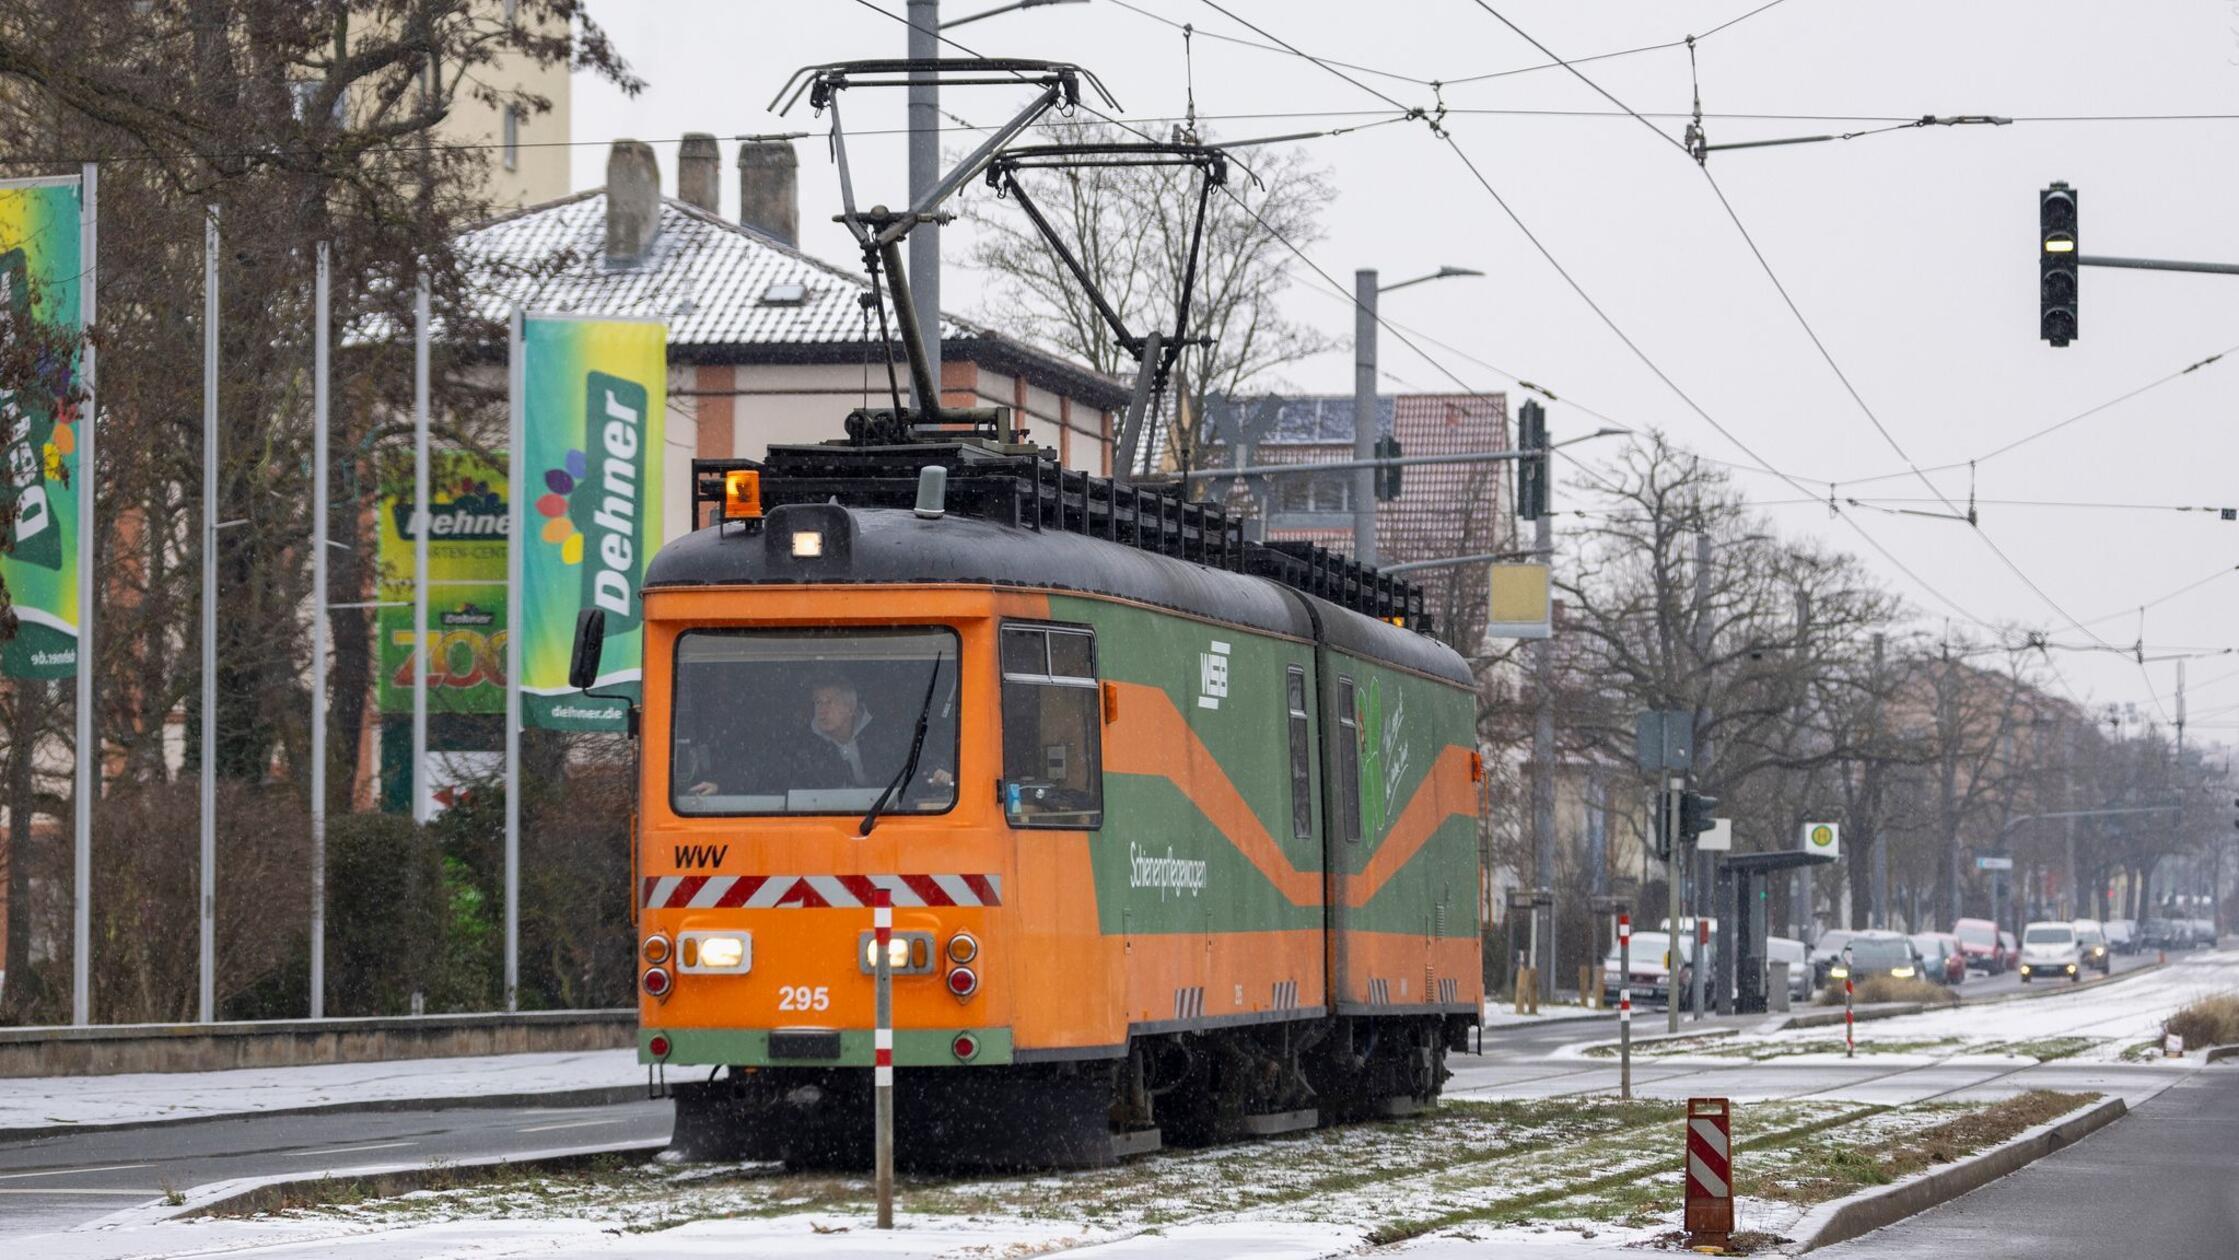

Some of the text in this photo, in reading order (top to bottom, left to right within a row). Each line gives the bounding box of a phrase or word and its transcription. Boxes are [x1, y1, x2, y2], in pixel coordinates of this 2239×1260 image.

[594, 389, 639, 617] Dehner
[406, 509, 511, 534] Dehne
[551, 705, 623, 720] dehner.de
[674, 844, 728, 868] WVV
[778, 985, 830, 1011] 295
